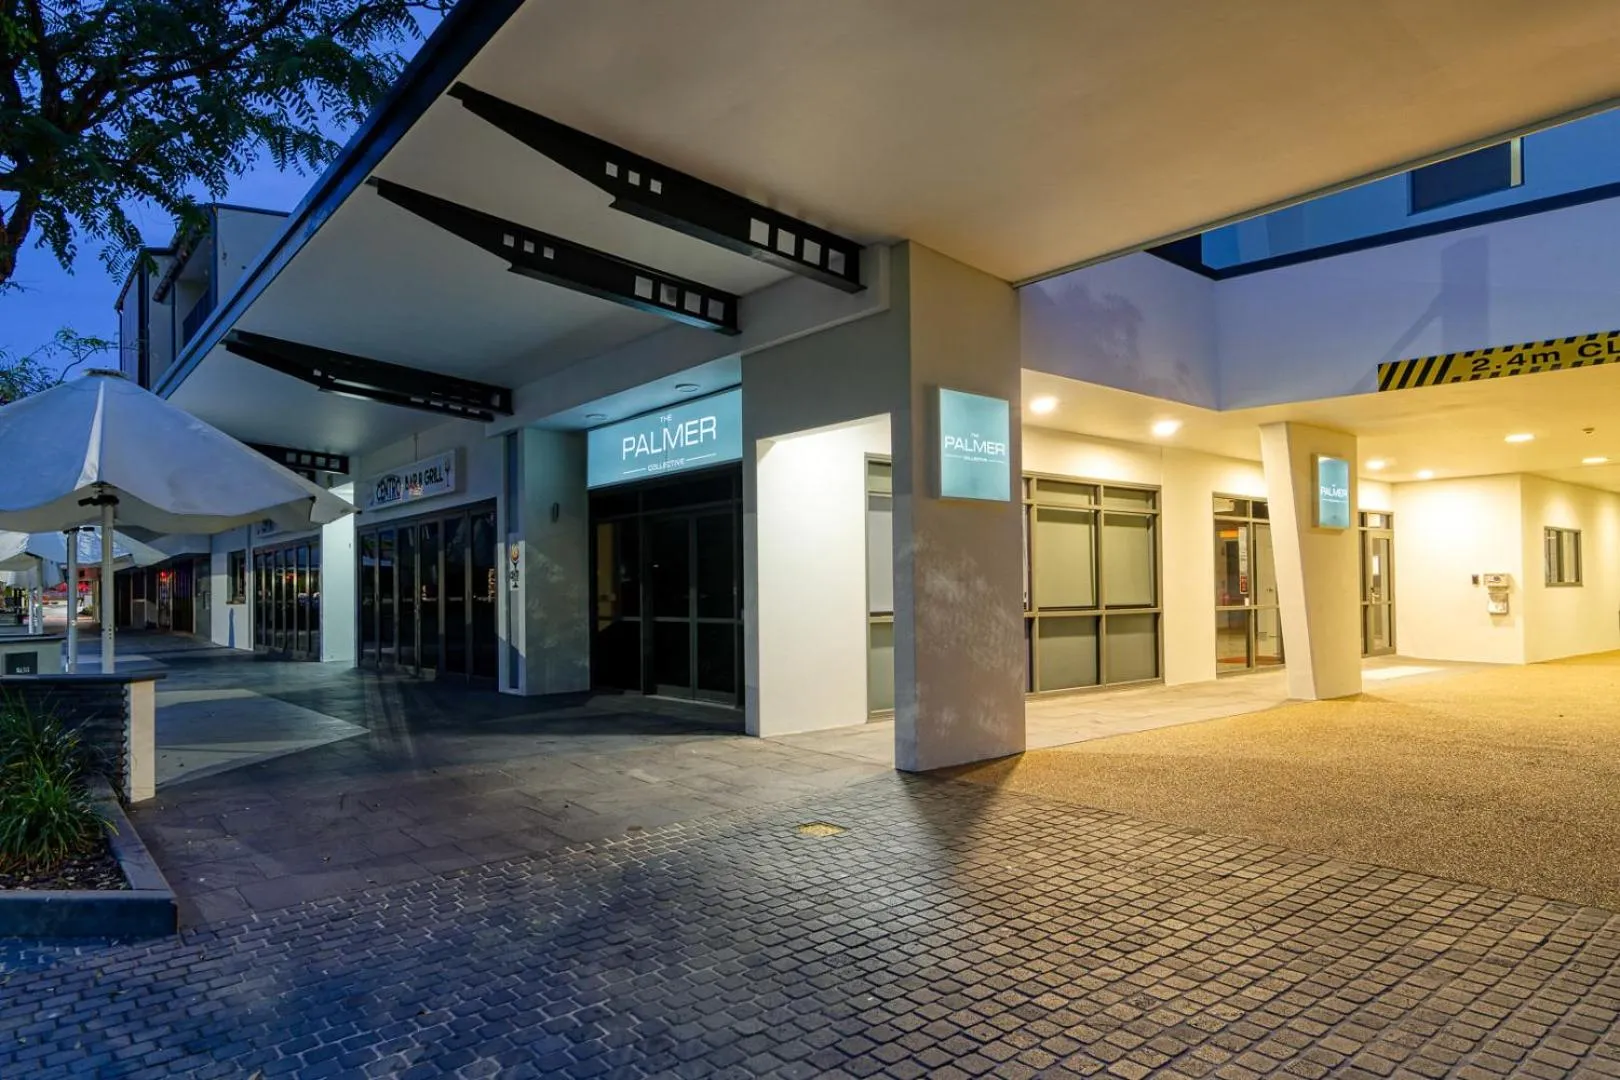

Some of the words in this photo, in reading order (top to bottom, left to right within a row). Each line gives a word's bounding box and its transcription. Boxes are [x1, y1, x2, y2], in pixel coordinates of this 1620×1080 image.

[1471, 351, 1561, 372] 2.4m
[660, 414, 673, 423] THE
[622, 415, 717, 461] PALMER
[944, 434, 1006, 456] PALMER
[647, 457, 686, 472] COLLECTIVE
[424, 466, 444, 486] GRILL
